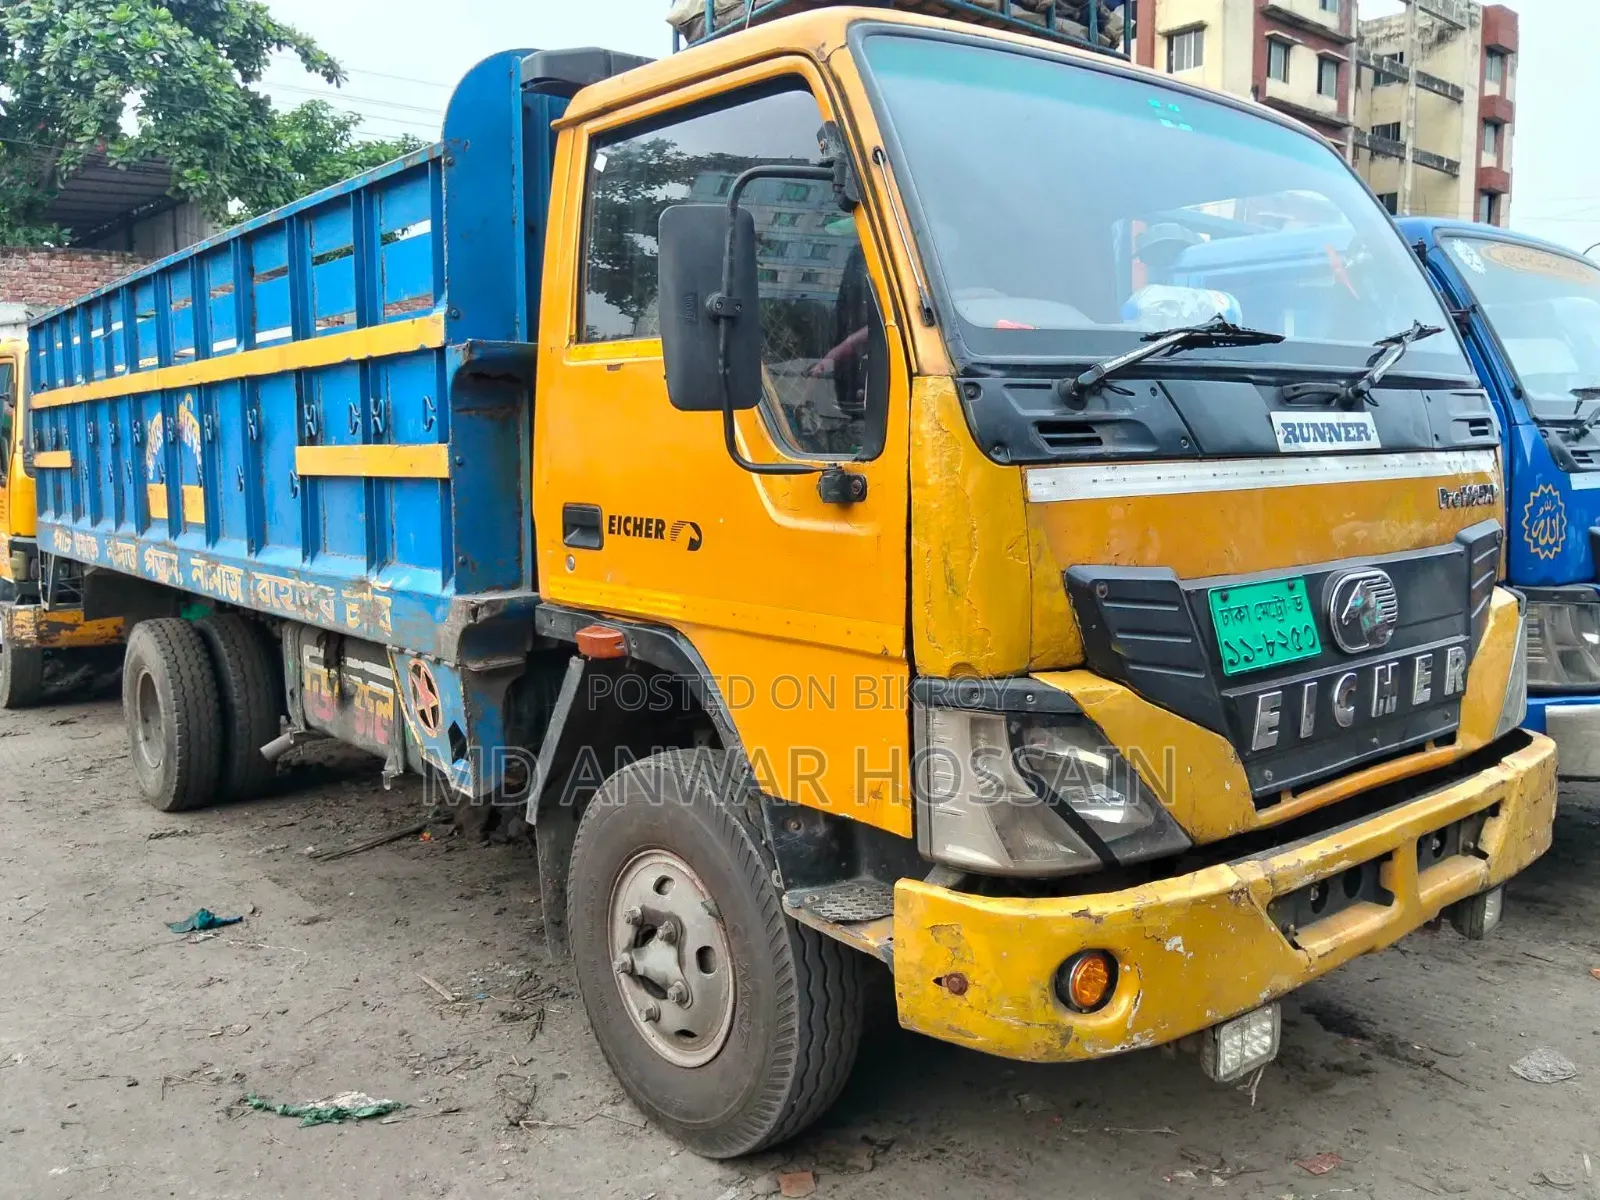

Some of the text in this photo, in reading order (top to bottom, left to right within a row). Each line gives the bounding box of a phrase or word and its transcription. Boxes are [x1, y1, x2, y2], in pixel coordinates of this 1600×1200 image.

[1280, 421, 1372, 445] RUNNER
[607, 514, 666, 540] EICHER
[190, 556, 245, 603] নামাজ
[1218, 604, 1251, 627] ঢাকা
[1251, 645, 1467, 752] EICHER
